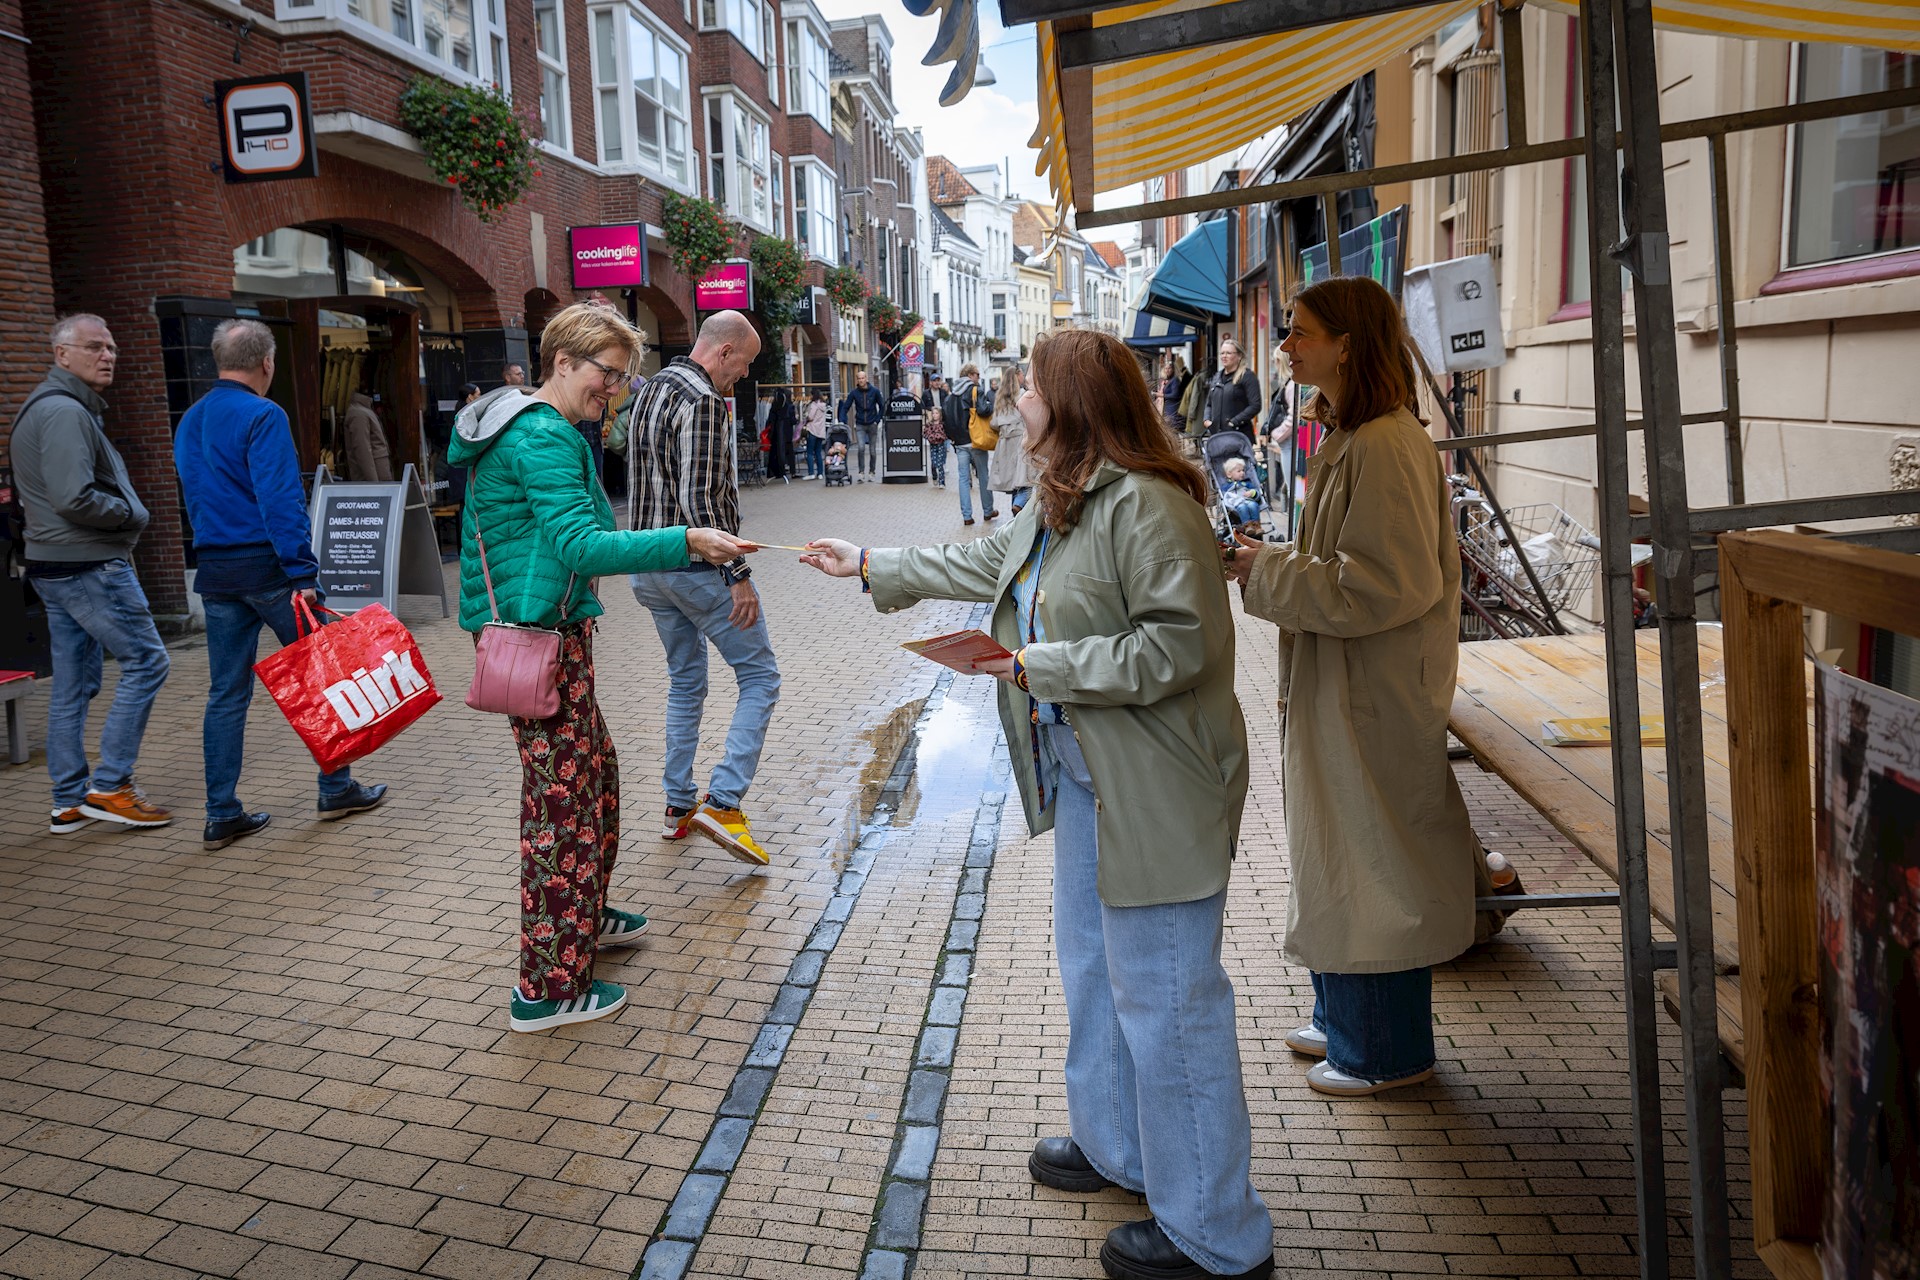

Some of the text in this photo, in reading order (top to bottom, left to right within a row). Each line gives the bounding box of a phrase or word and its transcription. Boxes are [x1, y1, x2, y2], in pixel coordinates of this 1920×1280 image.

[576, 245, 638, 260] cookinglife
[890, 400, 916, 408] COSMÉ
[328, 517, 353, 525] DAMES-
[360, 517, 383, 525] HEREN
[330, 531, 379, 539] WINTERJASSEN
[322, 650, 429, 733] Dirk
